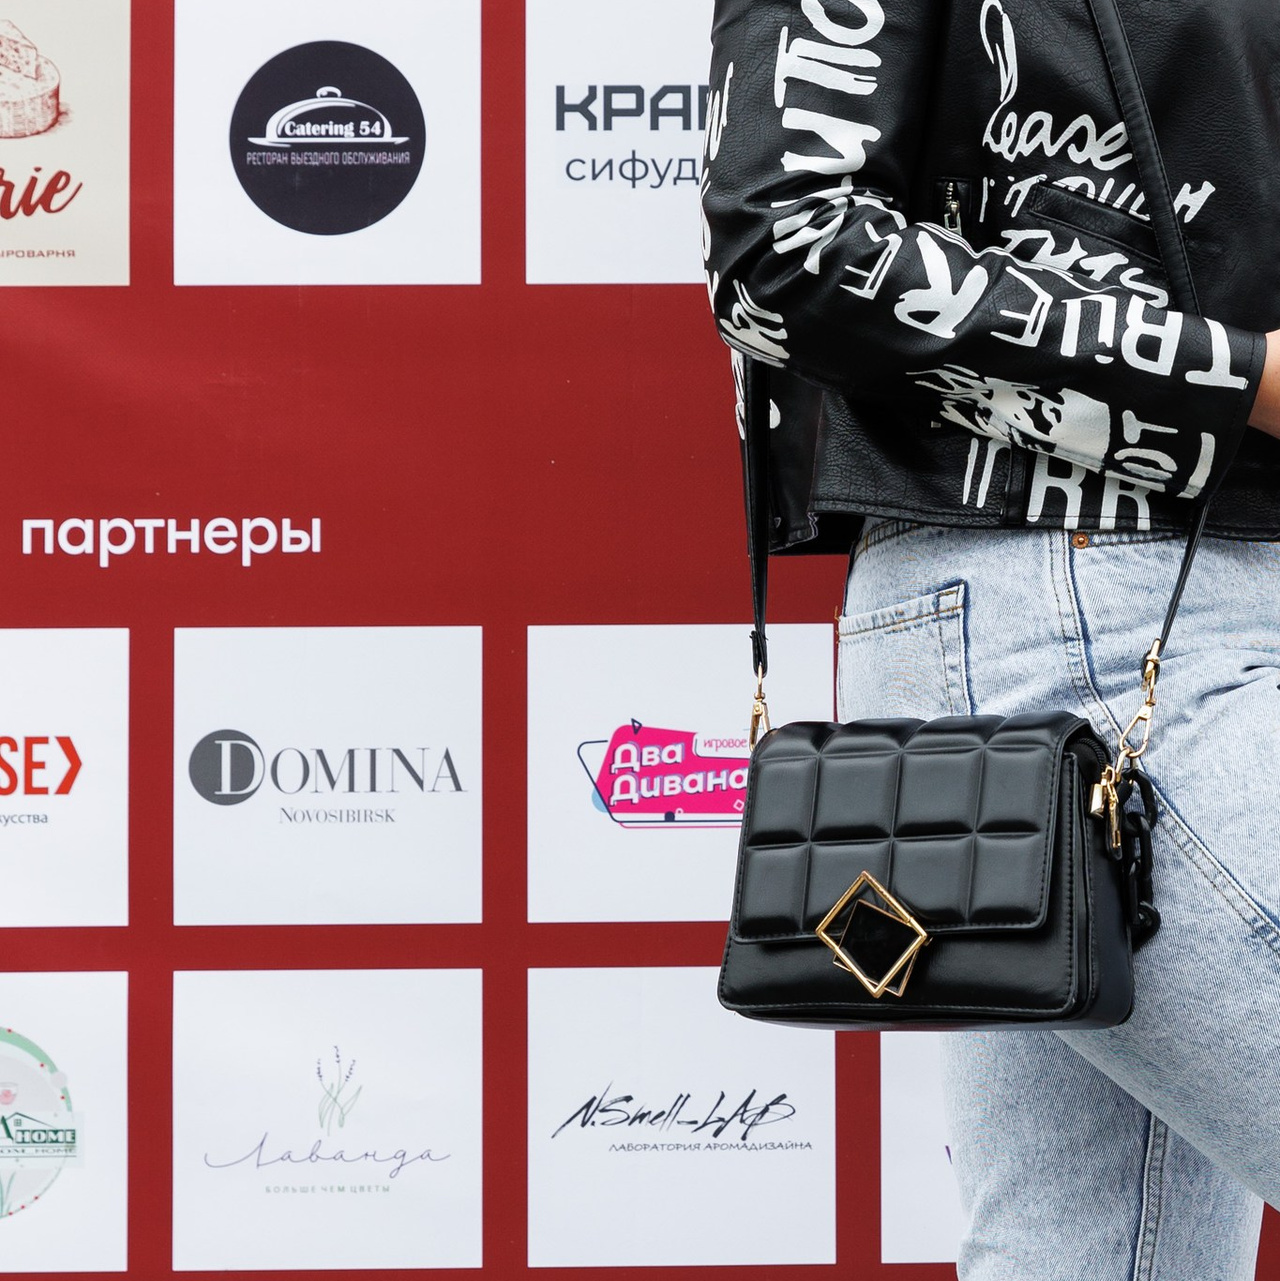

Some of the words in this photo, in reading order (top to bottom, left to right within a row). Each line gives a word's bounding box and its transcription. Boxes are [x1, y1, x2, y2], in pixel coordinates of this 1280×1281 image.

[556, 85, 709, 131] КРА
[284, 121, 355, 138] Catering
[359, 121, 382, 135] 54
[247, 151, 288, 166] РЕСТОРАН
[290, 151, 339, 167] ВЫЕЗДНОГО
[341, 151, 410, 165] ОБСЛУЖИВАНИЯ
[565, 150, 700, 189] сифуд
[21, 516, 321, 568] партнеры
[611, 742, 685, 774] Два
[704, 738, 747, 752] игровое
[214, 740, 468, 795] DOMINA
[204, 1131, 451, 1179] Лаванда
[609, 1142, 701, 1153] ЛАБОРАТОРИЯ
[703, 1140, 813, 1152] АРОМАДИЗАЙНА
[265, 1185, 316, 1194] БОЛЬШЕ
[321, 1185, 346, 1194] ЧЕМ
[350, 1185, 391, 1195] ЦВЕТЫ
